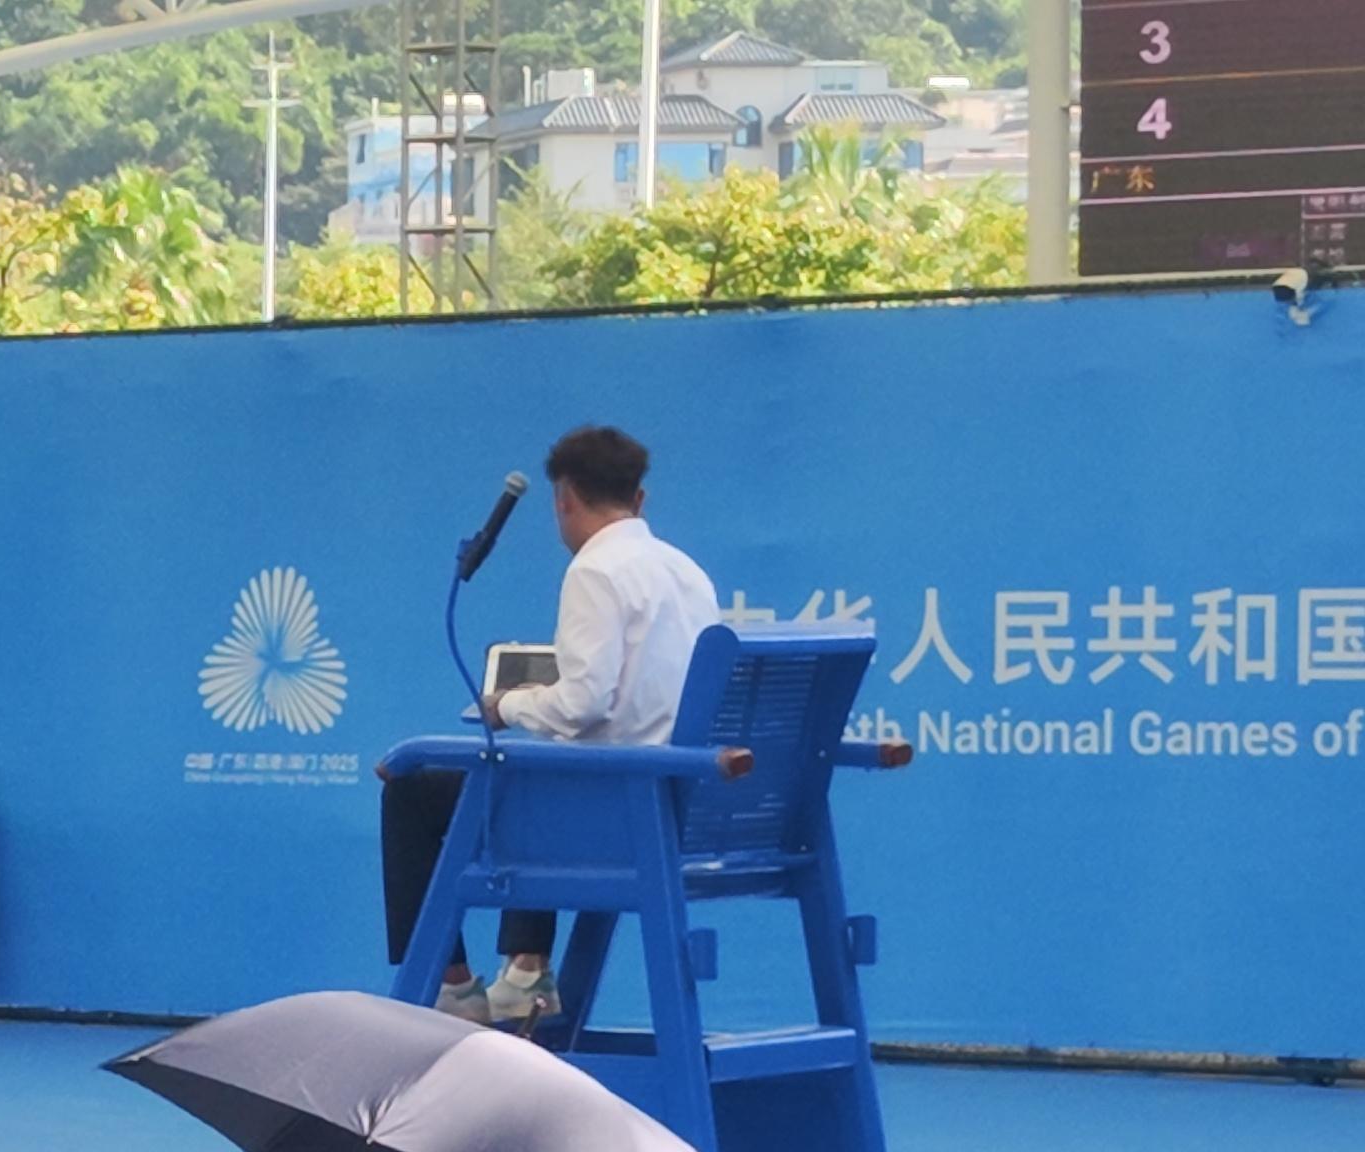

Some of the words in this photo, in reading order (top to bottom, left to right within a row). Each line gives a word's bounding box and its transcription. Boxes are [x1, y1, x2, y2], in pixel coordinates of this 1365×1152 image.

[1139, 20, 1171, 64] 3
[1136, 98, 1172, 140] 4
[918, 706, 1113, 755] National
[1130, 710, 1298, 757] Games
[1313, 708, 1365, 757] of
